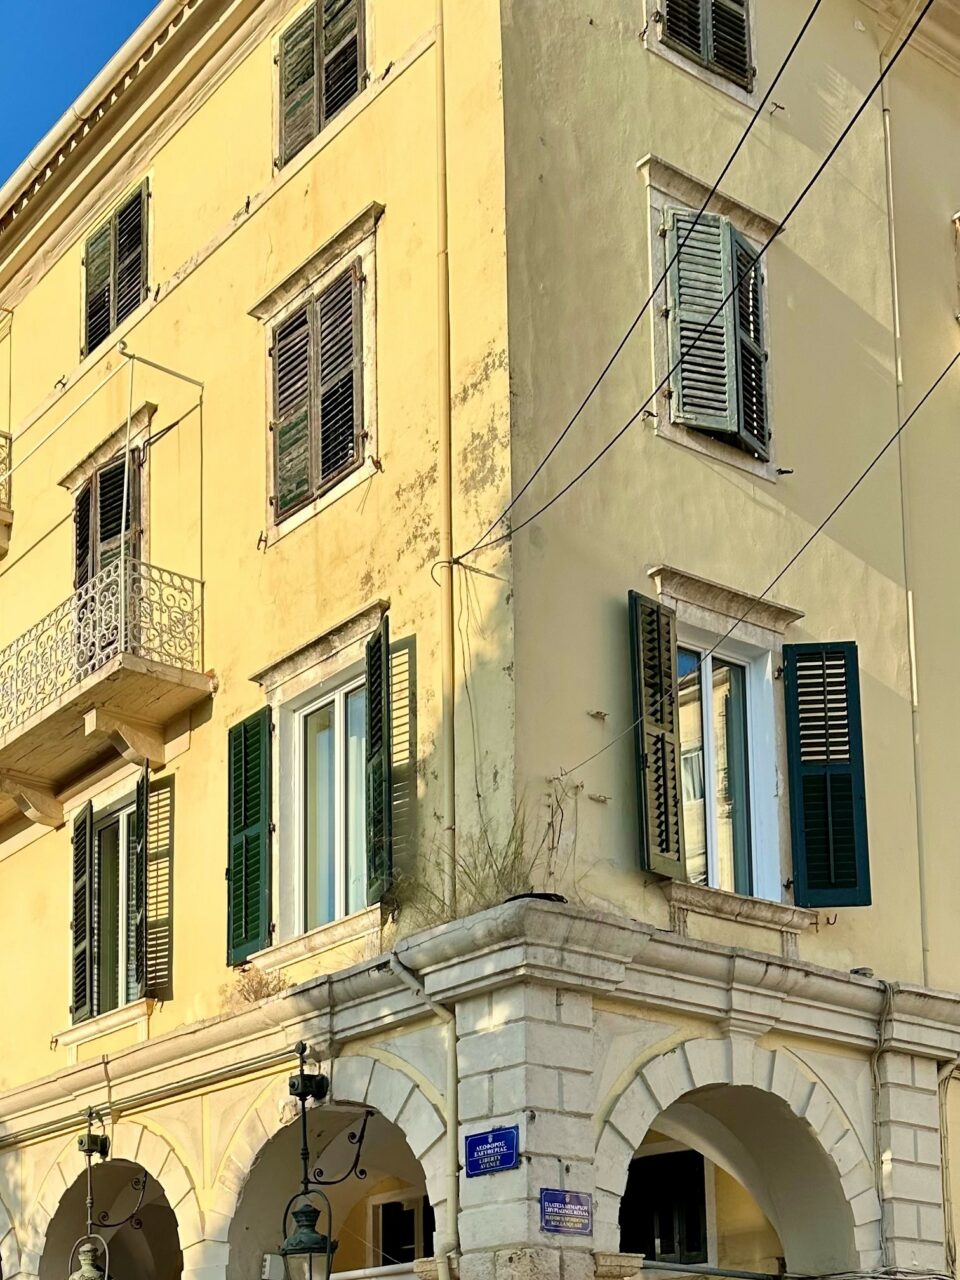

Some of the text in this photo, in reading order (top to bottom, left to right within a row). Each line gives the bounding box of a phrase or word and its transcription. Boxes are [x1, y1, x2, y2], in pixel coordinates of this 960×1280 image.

[476, 1141, 505, 1151] ΛΕΩΦΟΡΟΣ
[474, 1146, 507, 1157] ΕΛΕΥΘΕΡΙΑΣ
[480, 1161, 500, 1169] AVENUE
